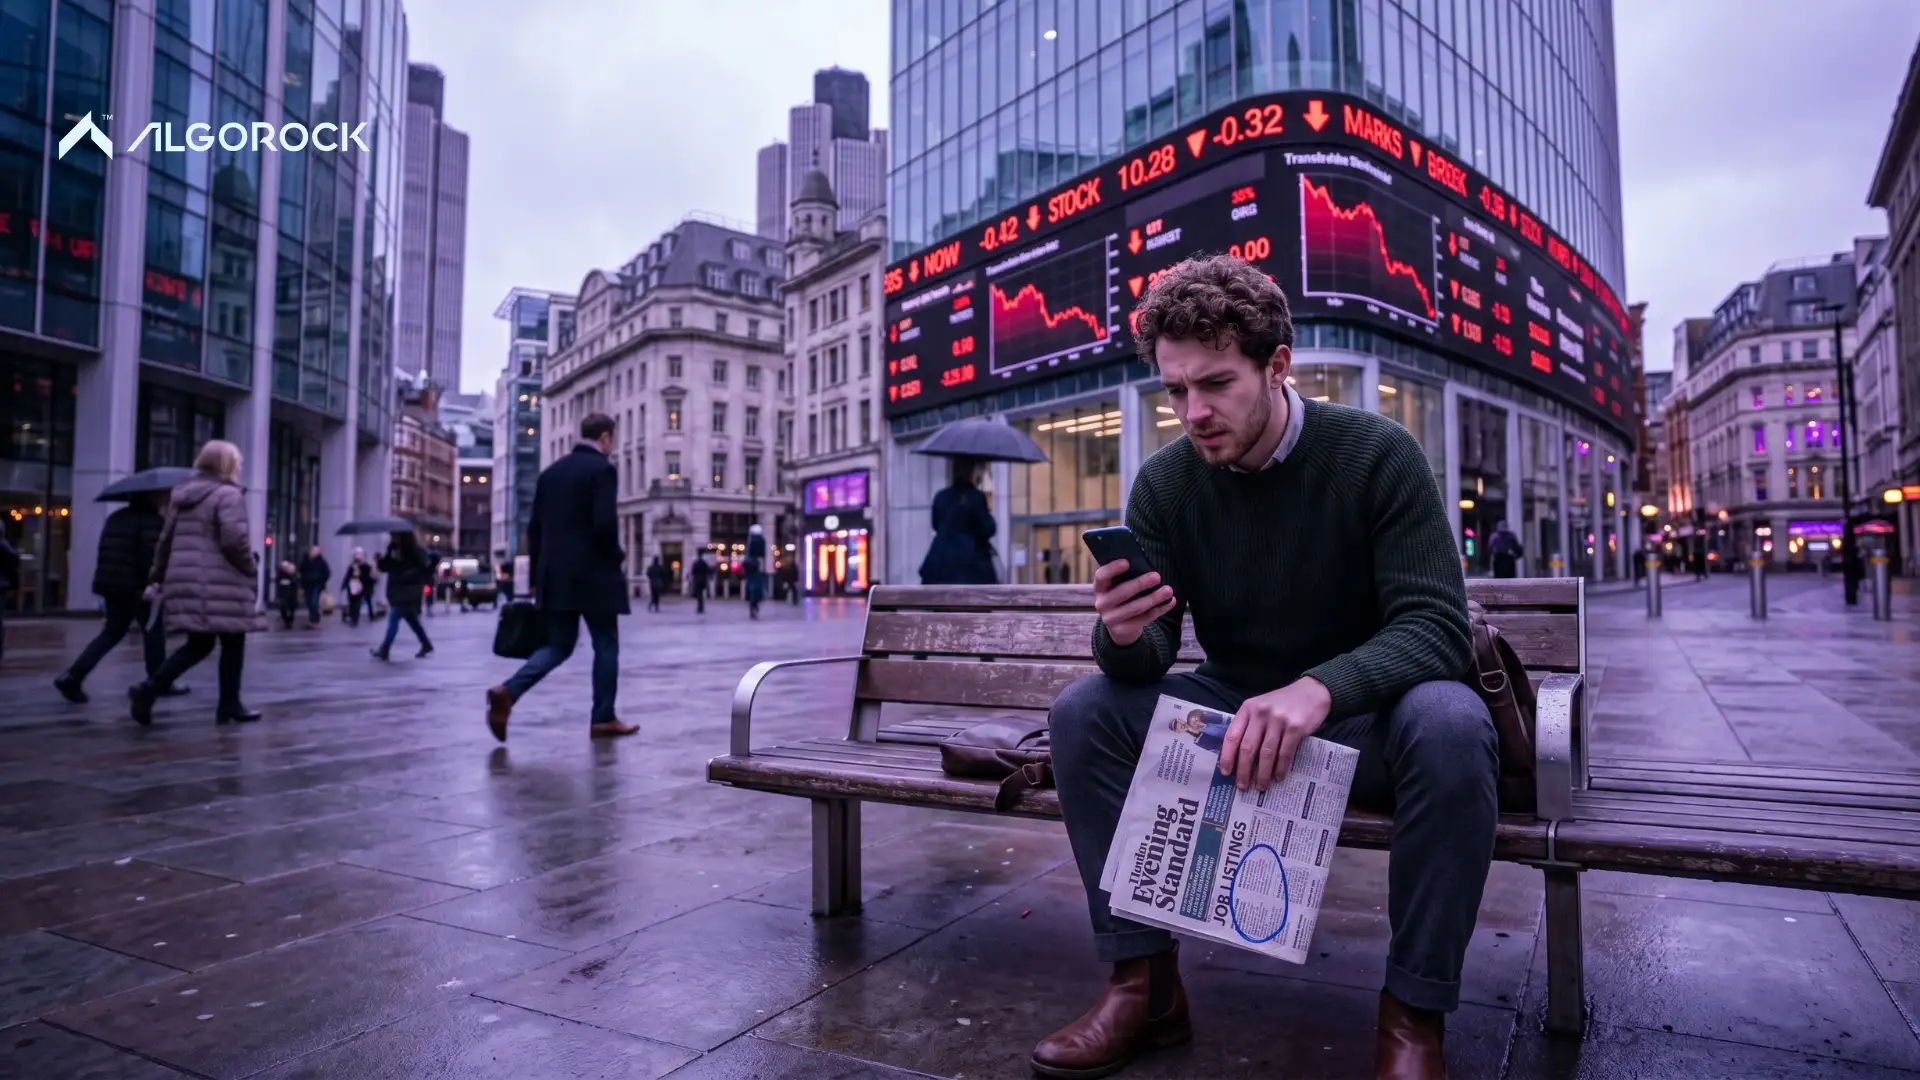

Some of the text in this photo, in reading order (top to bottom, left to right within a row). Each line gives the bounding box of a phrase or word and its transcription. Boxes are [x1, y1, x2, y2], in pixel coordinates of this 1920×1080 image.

[923, 241, 960, 277] NOW
[978, 216, 1019, 250] -0.42
[1047, 177, 1102, 223] STOCK
[1117, 144, 1176, 191] 10.28
[1213, 103, 1284, 146] -0.32
[1343, 104, 1404, 160] MARKS
[1131, 804, 1179, 907] Evening
[1155, 797, 1200, 913] Standard
[1213, 894, 1231, 927] JOB
